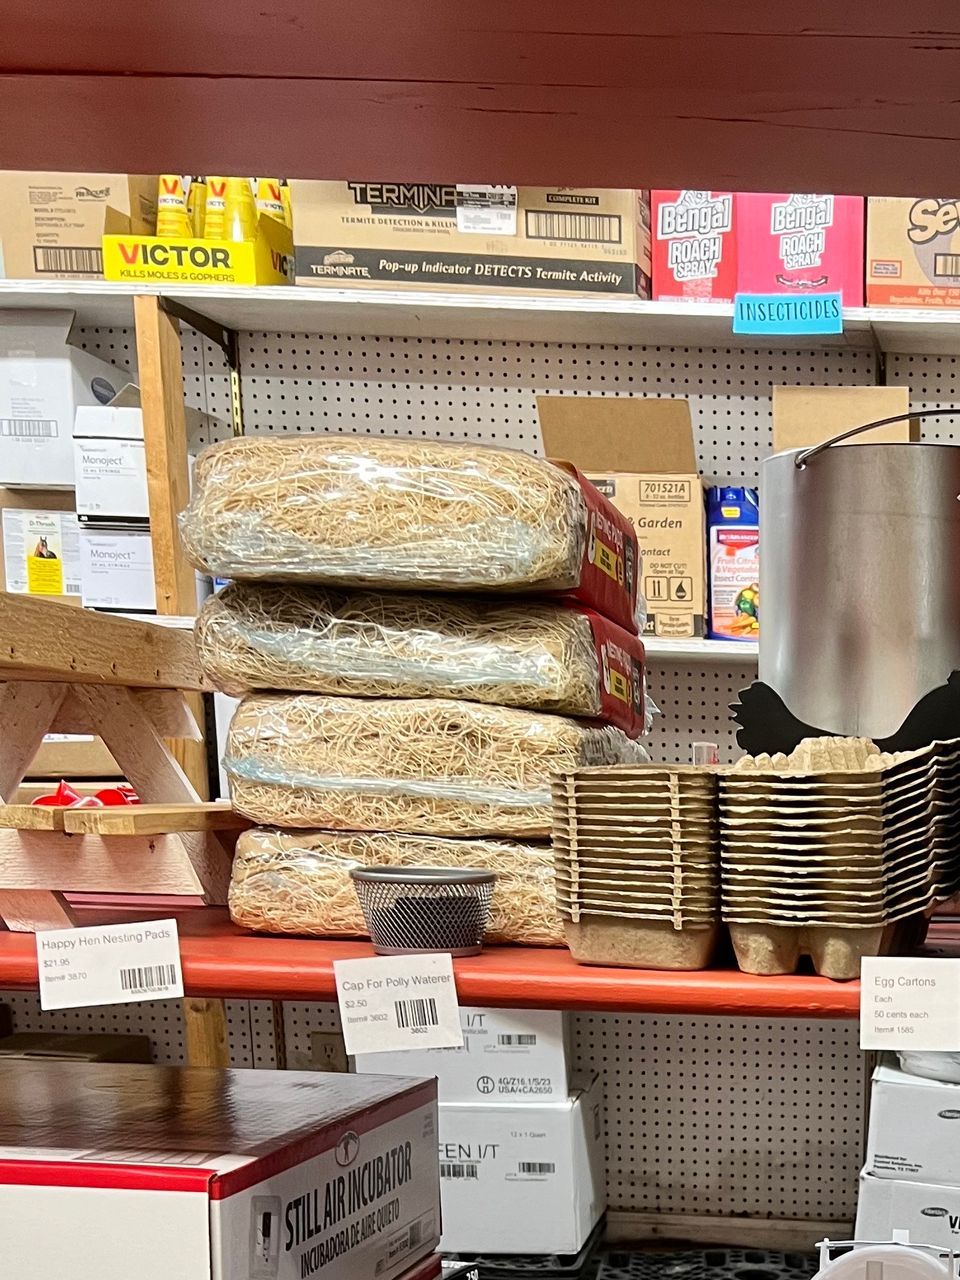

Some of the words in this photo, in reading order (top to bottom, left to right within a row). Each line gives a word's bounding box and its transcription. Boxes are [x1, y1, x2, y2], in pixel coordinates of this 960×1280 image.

[548, 194, 583, 203] COMPLETE
[341, 216, 375, 225] TERMITE
[378, 218, 423, 228] DETECTION
[662, 198, 731, 234] Bengal
[774, 199, 831, 232] Bengal
[672, 236, 721, 264] ROACH
[781, 232, 823, 257] ROACH
[117, 243, 230, 268] VICTOR
[787, 253, 816, 269] SPRAY
[120, 270, 145, 279] KILLS
[147, 271, 178, 281] MOLES
[190, 273, 235, 282] GOPHERS
[311, 264, 370, 278] TERMINATE
[379, 259, 419, 273] Pop-up
[422, 261, 471, 275] Indicator
[474, 264, 532, 278] DETECTS
[536, 268, 577, 281] Termite
[581, 271, 622, 286] Activity
[677, 261, 712, 278] SPRAY
[740, 299, 839, 321] INSECTICIDES
[82, 454, 122, 466] Monoject
[644, 483, 685, 493] 701521A
[638, 517, 682, 528] Garden
[42, 939, 75, 951] Happy
[79, 937, 100, 947] Hen
[103, 933, 143, 944] Nesting
[145, 929, 170, 940] Pads
[44, 958, 70, 968] $21.95
[342, 981, 364, 992] Cap
[367, 979, 383, 989] For
[386, 977, 410, 988] Polly
[411, 974, 451, 985] Waterer
[874, 975, 895, 988] Egg
[898, 975, 936, 987] Cartons
[345, 1000, 368, 1009] $2.50
[874, 995, 893, 1003] Each
[467, 1014, 485, 1027] I/T
[886, 1010, 907, 1019] cents
[909, 1010, 929, 1019] each
[478, 1144, 500, 1159] I/T
[285, 1188, 321, 1251] STILL
[323, 1174, 346, 1230] AIR
[348, 1141, 412, 1222] INCUBATOR
[300, 1230, 350, 1279] INCUBADORA
[360, 1214, 375, 1241] AIRE
